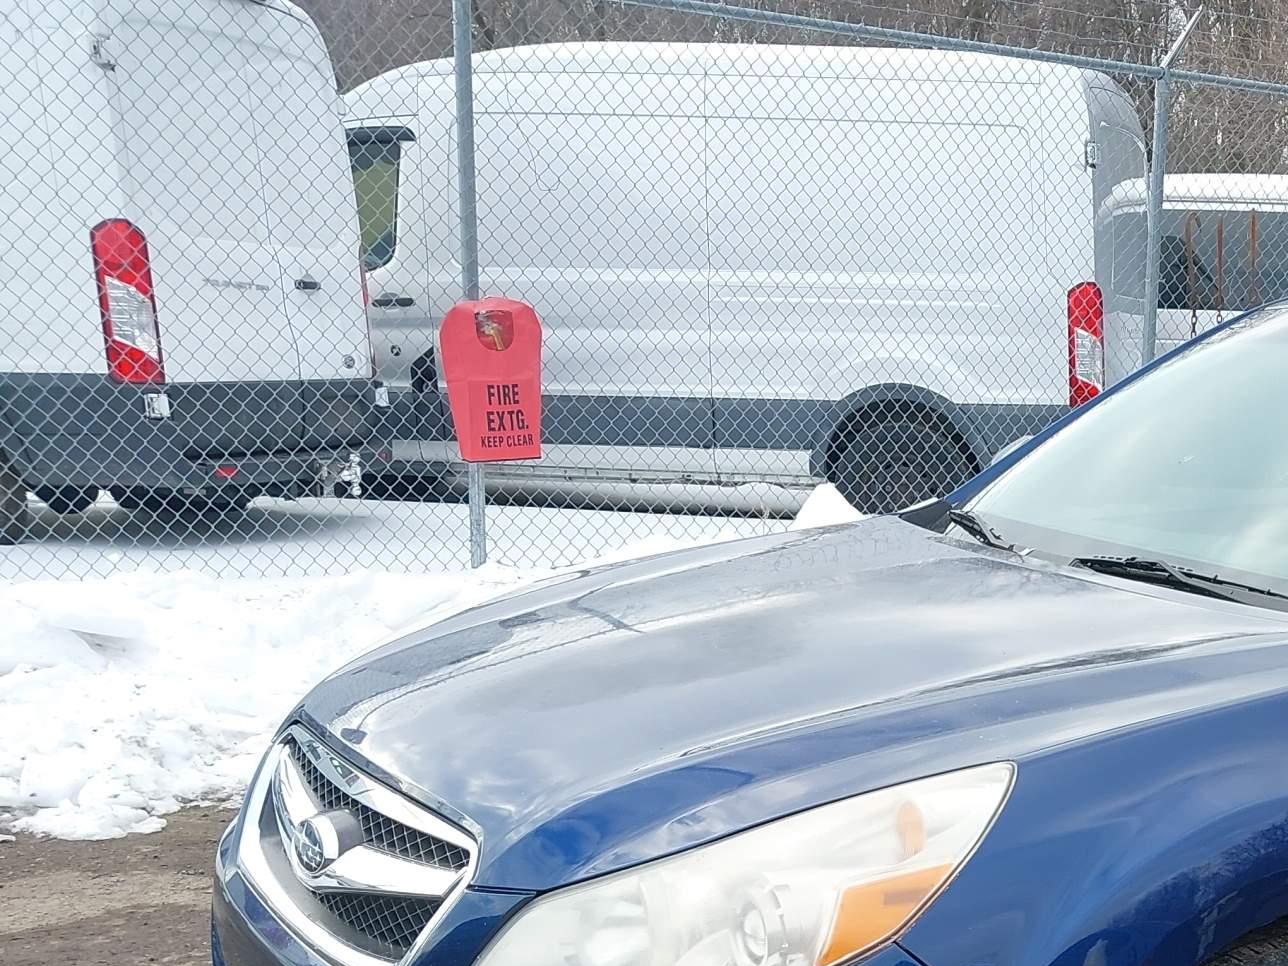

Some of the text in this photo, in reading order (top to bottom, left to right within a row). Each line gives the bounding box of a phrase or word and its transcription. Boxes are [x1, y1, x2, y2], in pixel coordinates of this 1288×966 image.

[487, 384, 520, 405] FIRE
[486, 409, 529, 432] EXTG.
[480, 433, 534, 448] KEEP CLEAR
